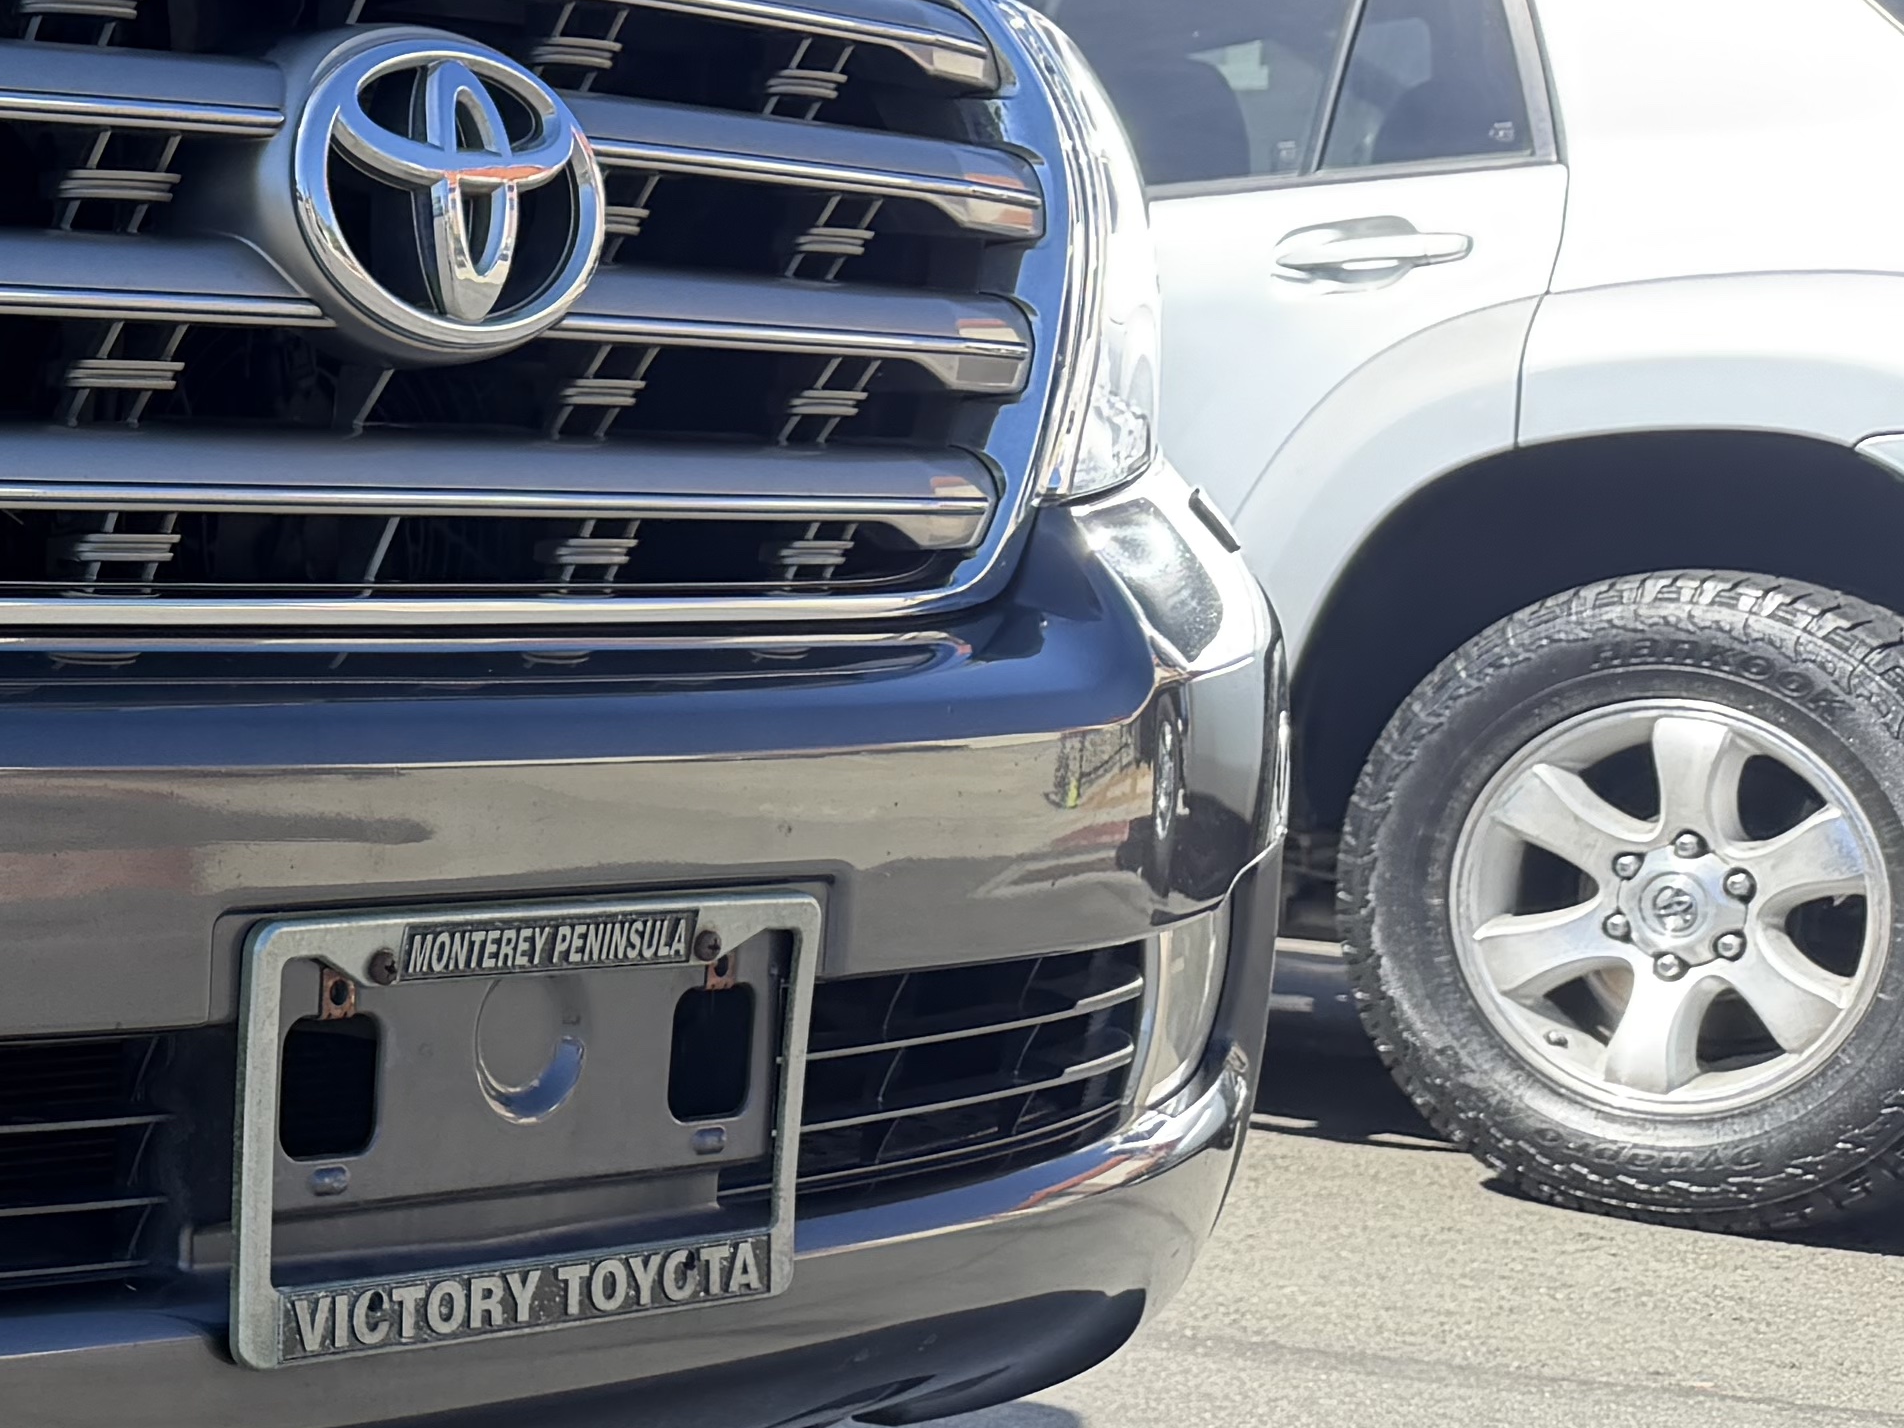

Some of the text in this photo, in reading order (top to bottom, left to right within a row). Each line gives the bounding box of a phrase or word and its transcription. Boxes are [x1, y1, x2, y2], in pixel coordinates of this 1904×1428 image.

[408, 918, 687, 974] MONTEREY PENINSULA
[293, 1269, 542, 1352] VICTORY
